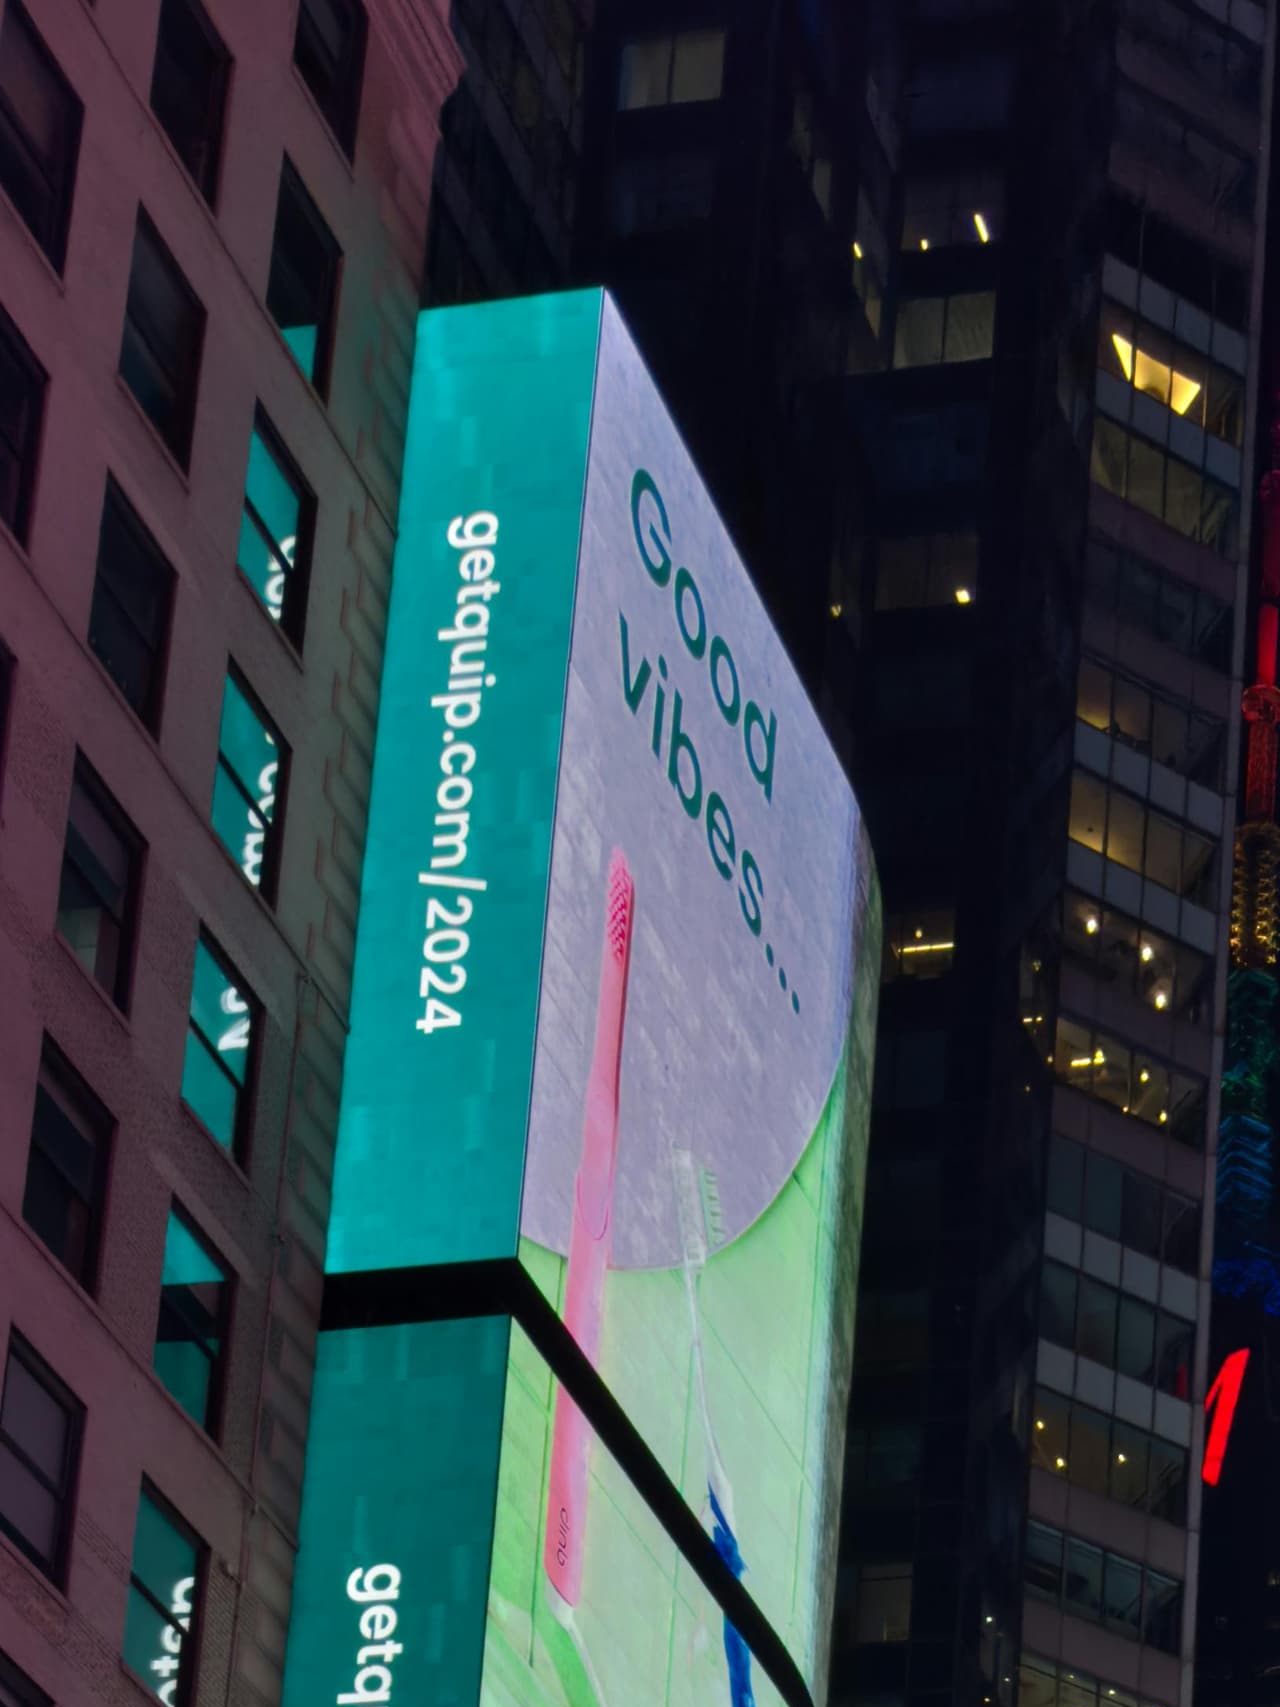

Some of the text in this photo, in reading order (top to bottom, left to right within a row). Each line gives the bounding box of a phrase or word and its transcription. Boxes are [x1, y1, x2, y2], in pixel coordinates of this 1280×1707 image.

[411, 509, 502, 1035] getquip.com/2024
[618, 609, 801, 1015] vibes...
[631, 467, 778, 802] Good
